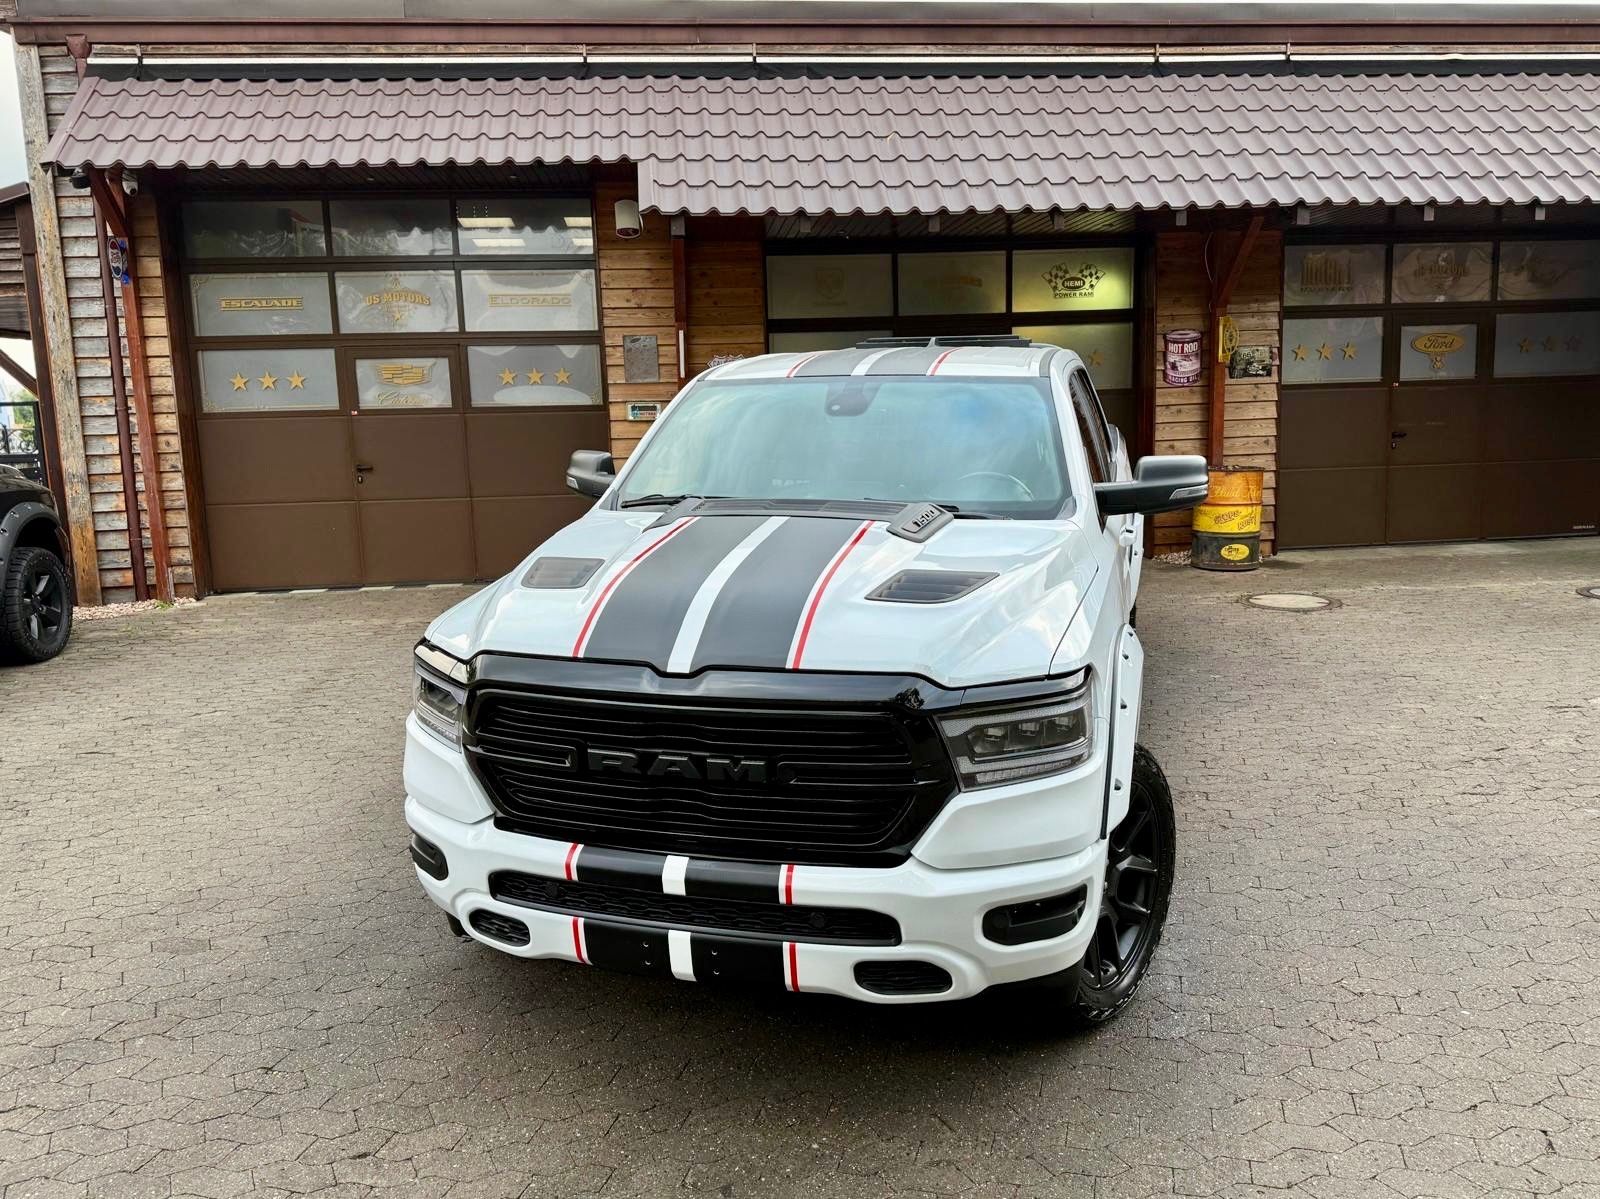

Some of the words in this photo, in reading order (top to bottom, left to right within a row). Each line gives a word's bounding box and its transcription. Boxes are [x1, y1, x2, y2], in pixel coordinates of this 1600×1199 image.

[222, 299, 303, 308] ESCALADE
[490, 296, 571, 305] ELDORADO
[1168, 343, 1183, 354] HOT
[1184, 342, 1198, 353] ROD
[1424, 336, 1456, 350] Ford
[911, 508, 938, 528] 1500
[587, 748, 767, 782] RAM
